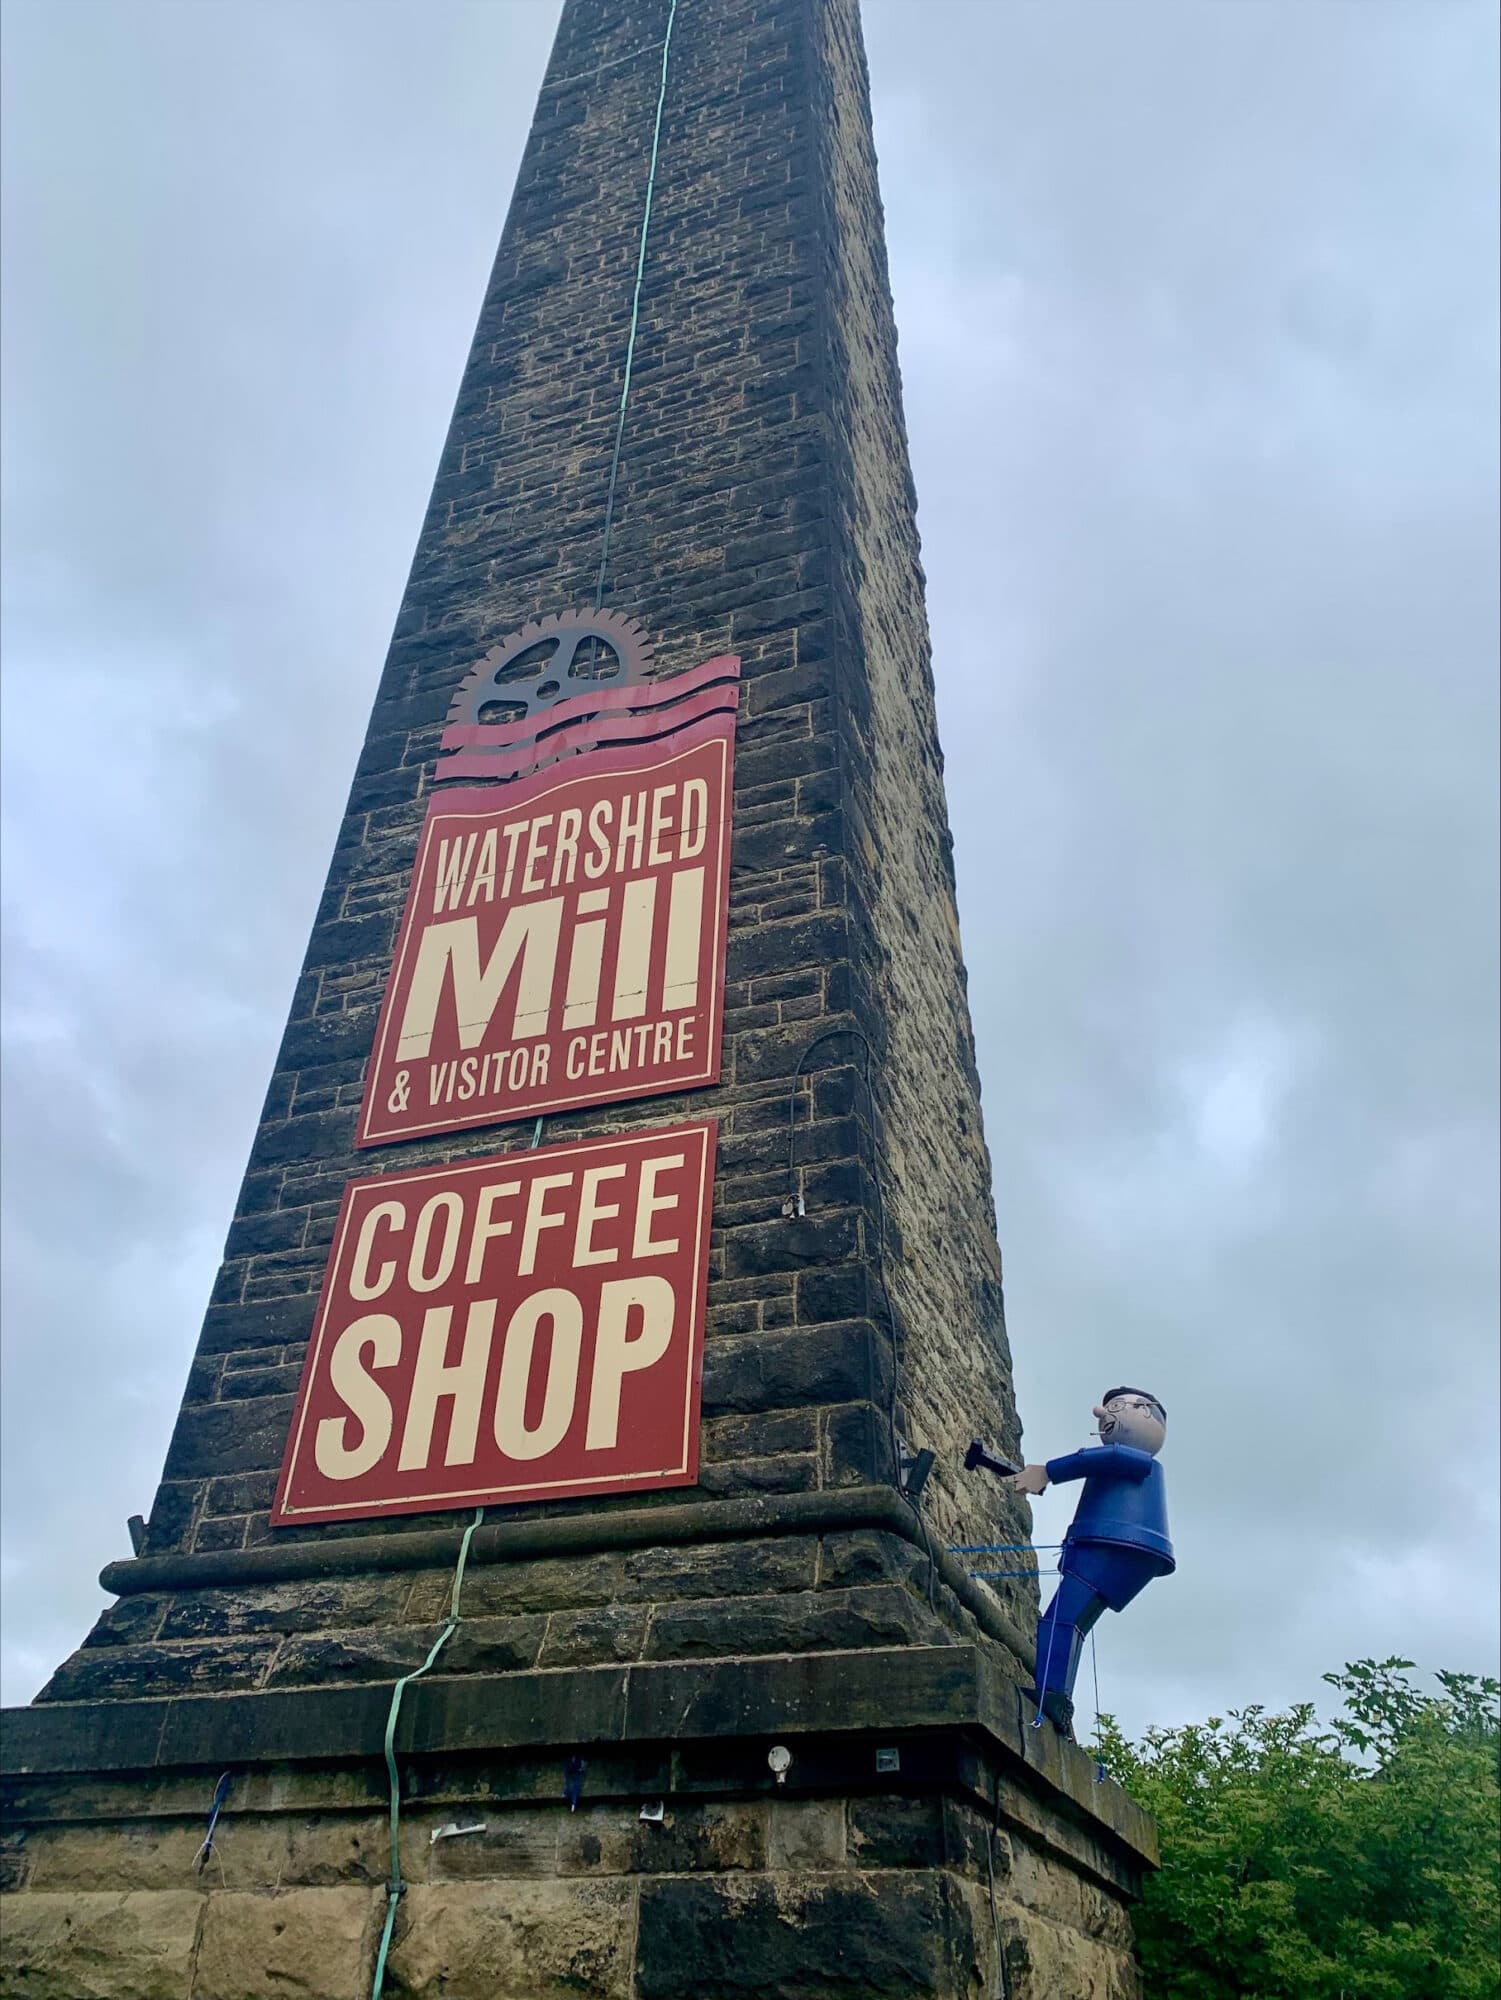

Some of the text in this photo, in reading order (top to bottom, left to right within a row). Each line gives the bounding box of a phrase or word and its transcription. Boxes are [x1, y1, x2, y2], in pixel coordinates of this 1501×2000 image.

[432, 778, 708, 914] WATERSHED
[395, 866, 705, 1063] Mill
[387, 1016, 696, 1114] & VISITOR CENTRE
[349, 1154, 685, 1301] COFFEE
[314, 1275, 675, 1480] SHOP
